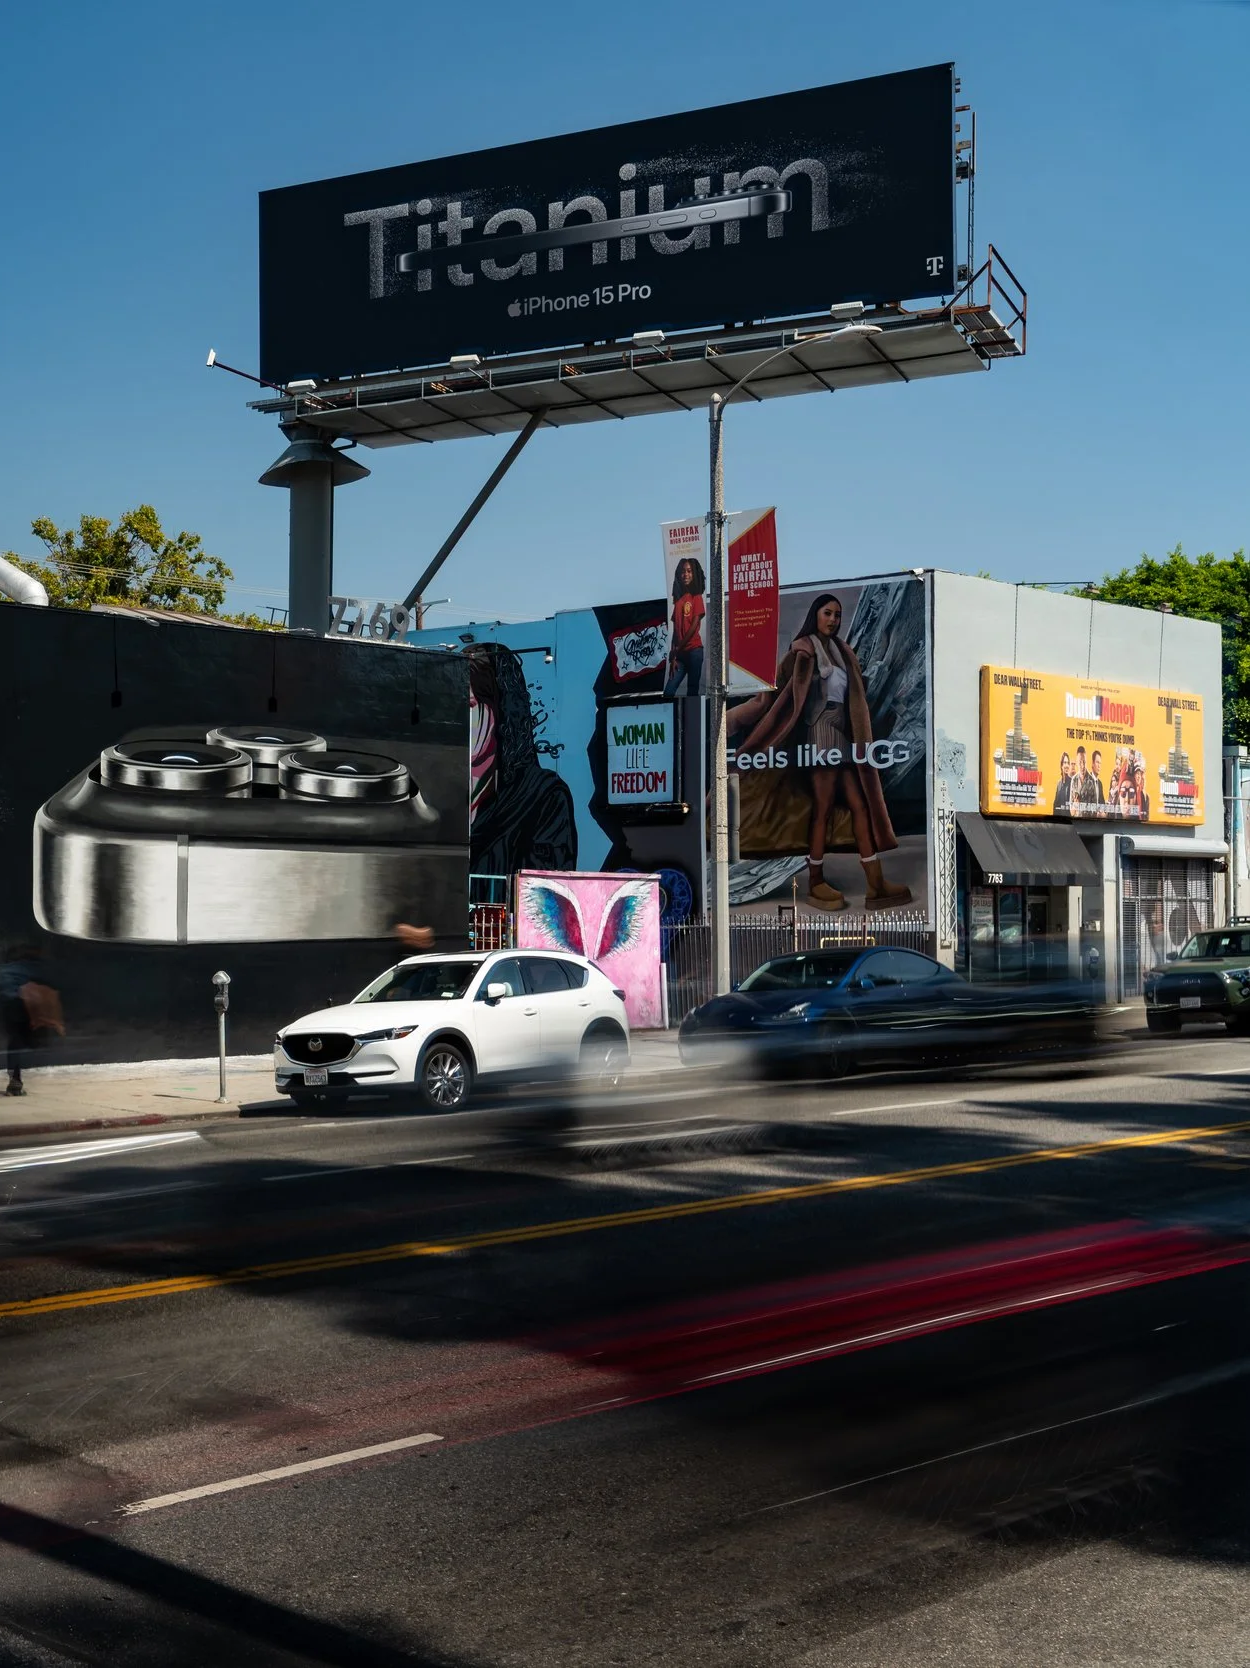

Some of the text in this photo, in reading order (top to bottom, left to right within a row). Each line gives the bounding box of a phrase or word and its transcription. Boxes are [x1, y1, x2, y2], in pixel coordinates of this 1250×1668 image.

[344, 158, 830, 299] Titanium
[524, 283, 652, 316] iPhone 15 Pro
[669, 525, 699, 538] FAIRFAX
[682, 535, 700, 543] SCHOOL
[741, 552, 766, 563] WHAT I
[733, 560, 774, 573] LOVE ABOUT
[733, 568, 773, 583] FAIRFAX
[733, 580, 774, 591] HIGH SCHOOL
[994, 673, 1008, 686] DEAR
[1008, 675, 1022, 688] WALL
[1158, 696, 1170, 708] DEAR
[1100, 696, 1135, 728] Money
[612, 722, 665, 746] WOMAN
[1066, 728, 1075, 739] THE
[1075, 729, 1085, 740] TOP
[1092, 731, 1108, 742] THINKS
[1122, 734, 1135, 745] DUMB
[626, 747, 650, 769] LIFE
[797, 743, 842, 767] like
[852, 739, 910, 769] UGG
[611, 770, 667, 794] FREEDOM
[988, 873, 1003, 884] 7763
